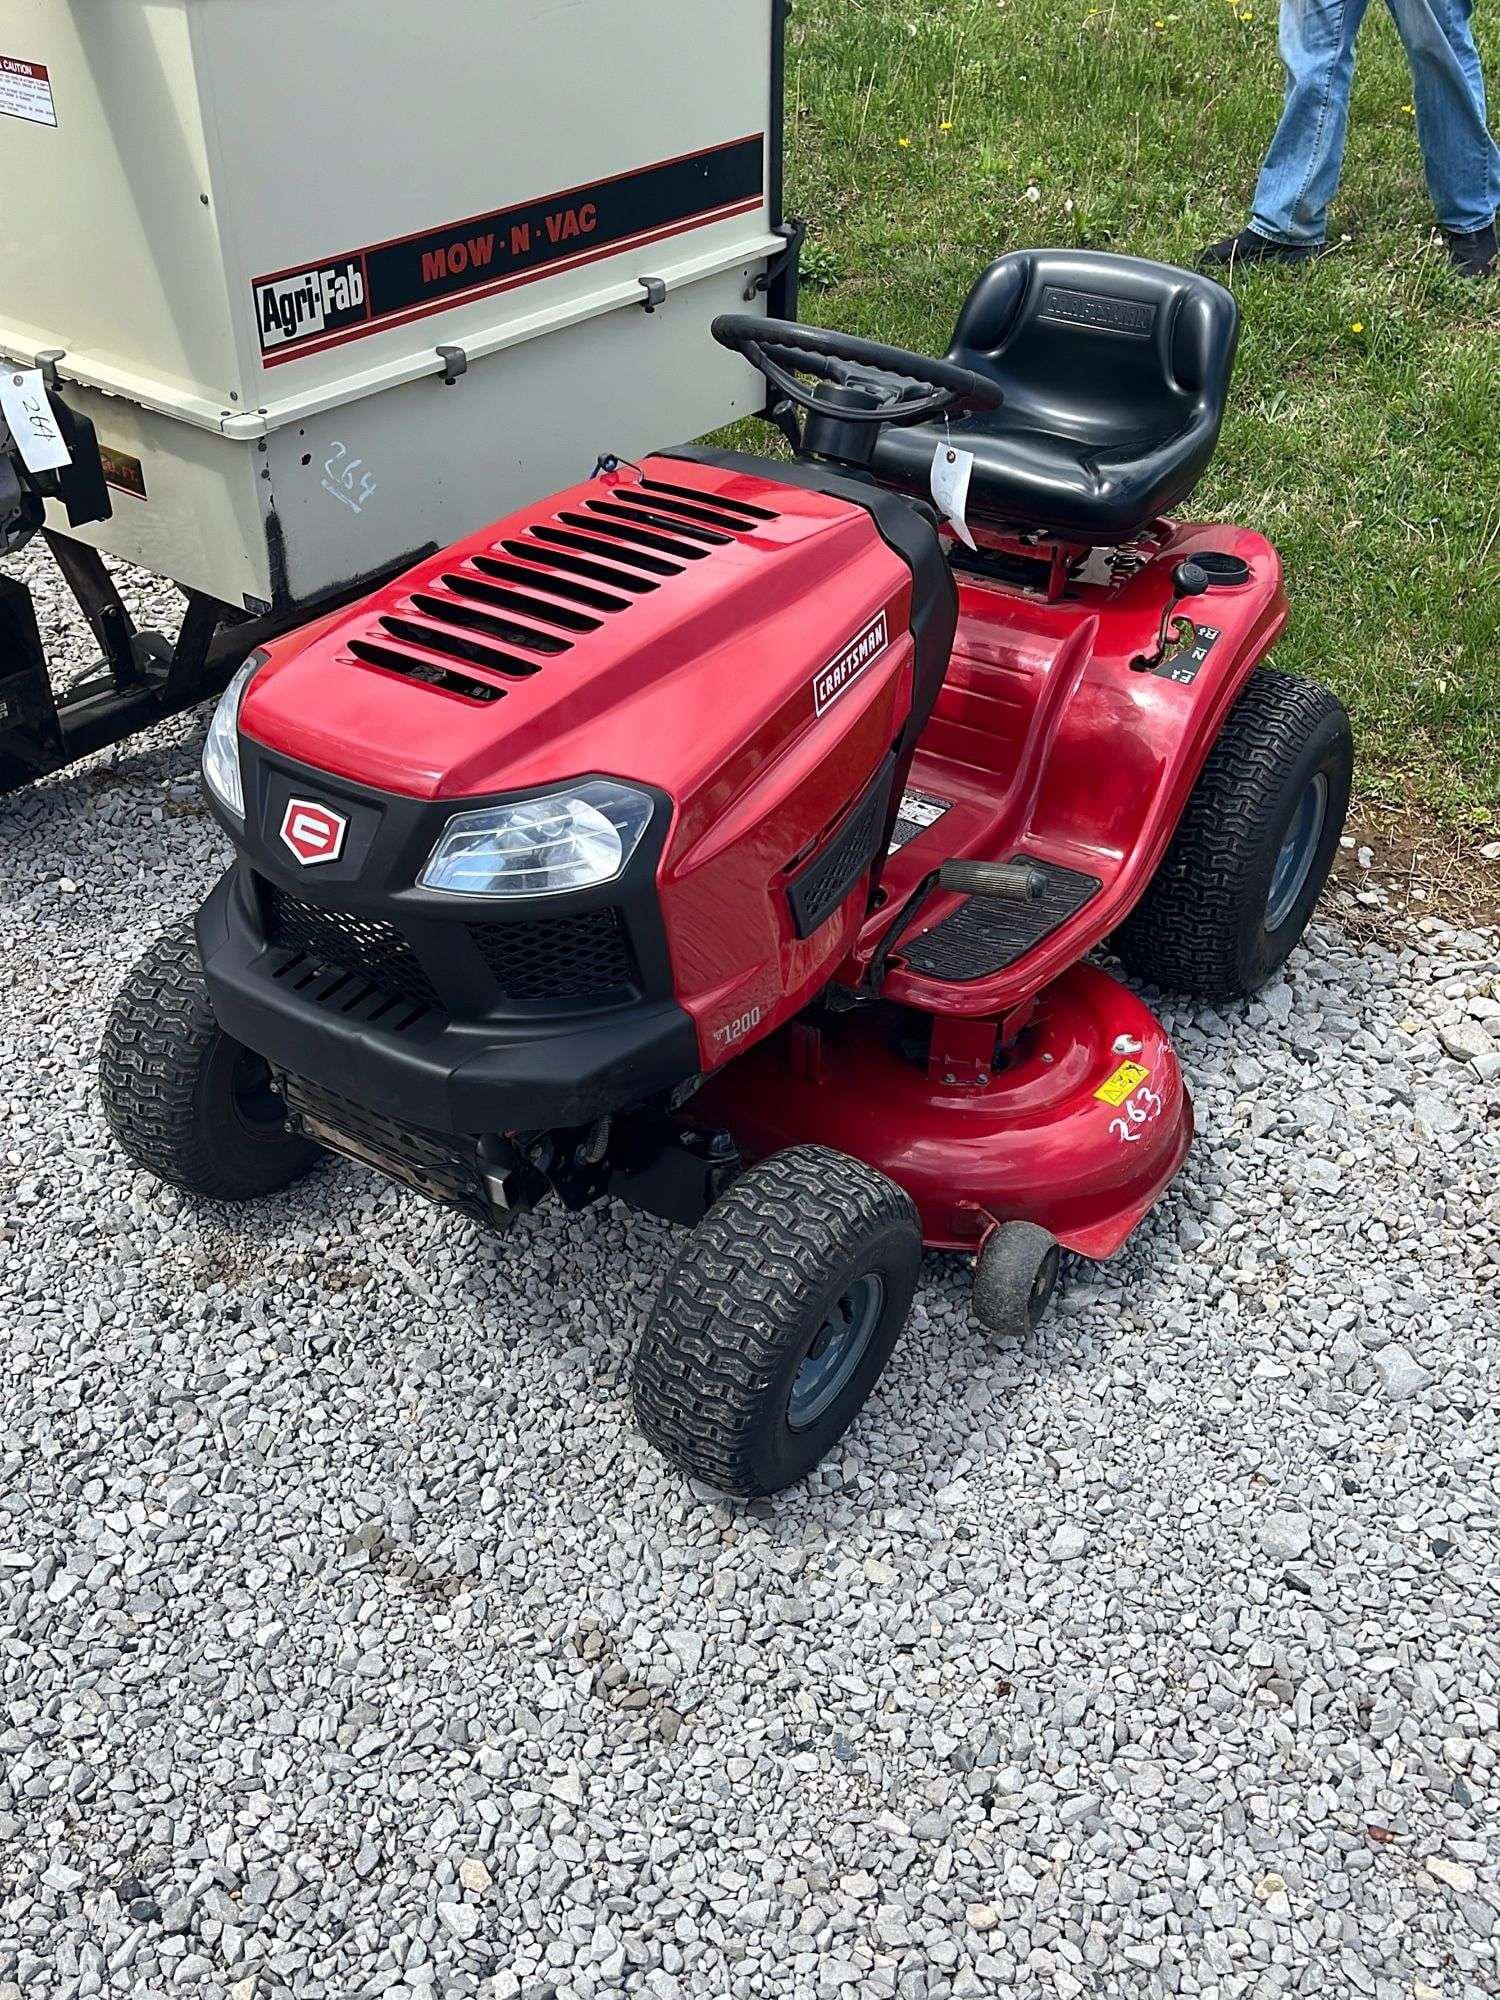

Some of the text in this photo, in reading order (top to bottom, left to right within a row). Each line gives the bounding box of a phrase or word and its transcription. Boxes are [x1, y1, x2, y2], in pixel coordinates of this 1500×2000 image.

[3, 59, 33, 76] CAUTION
[421, 202, 598, 283] MOW N VAC
[323, 440, 378, 506] 264
[818, 623, 883, 702] CRAFTSMAN
[1108, 1086, 1162, 1141] 263
